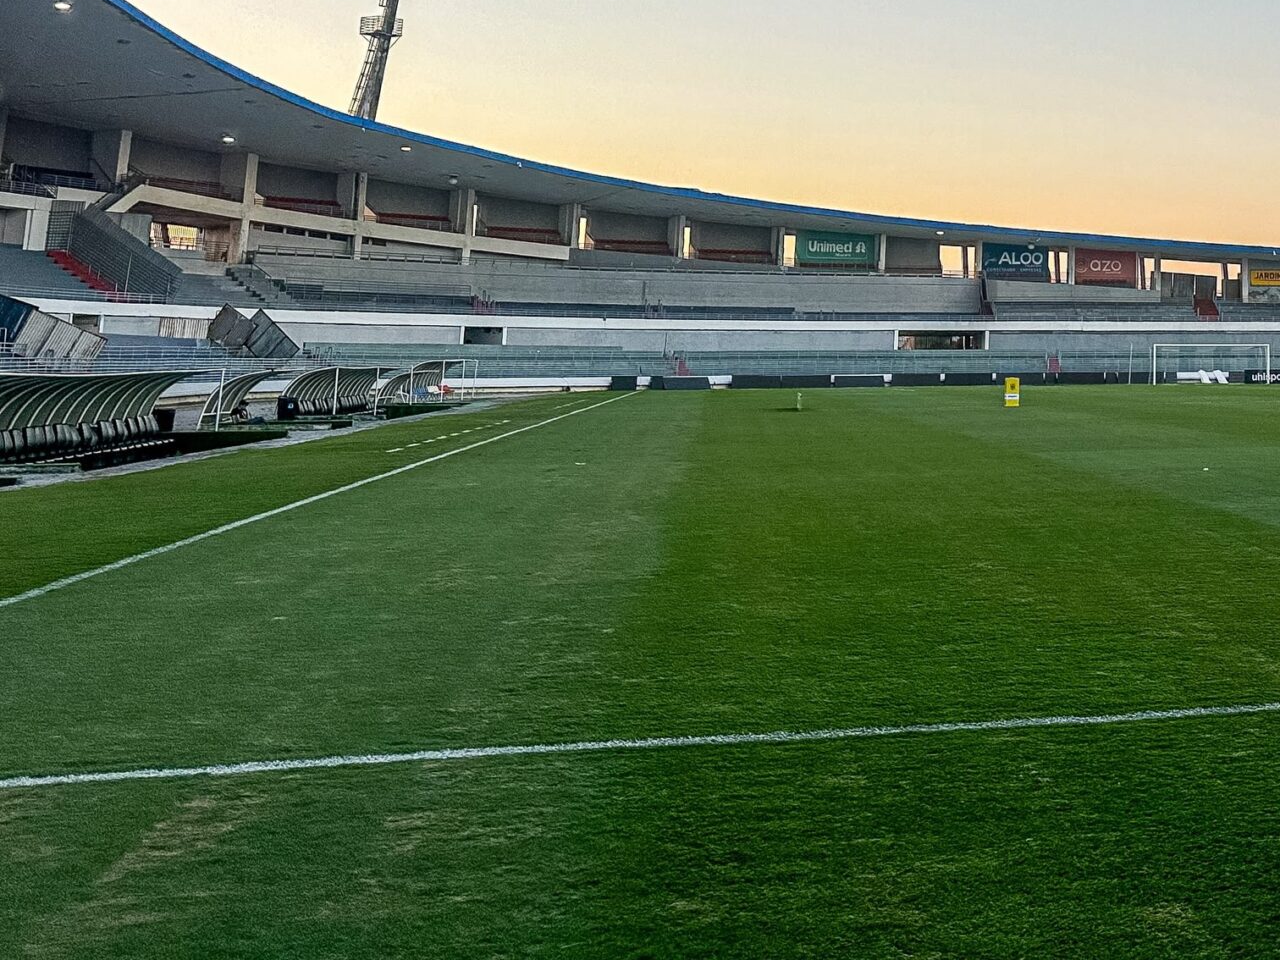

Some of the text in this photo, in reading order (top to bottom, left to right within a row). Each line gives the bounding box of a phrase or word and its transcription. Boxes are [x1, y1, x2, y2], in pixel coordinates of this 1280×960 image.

[808, 240, 853, 253] Unimed
[998, 251, 1043, 265] ALOO
[1090, 259, 1122, 272] azo
